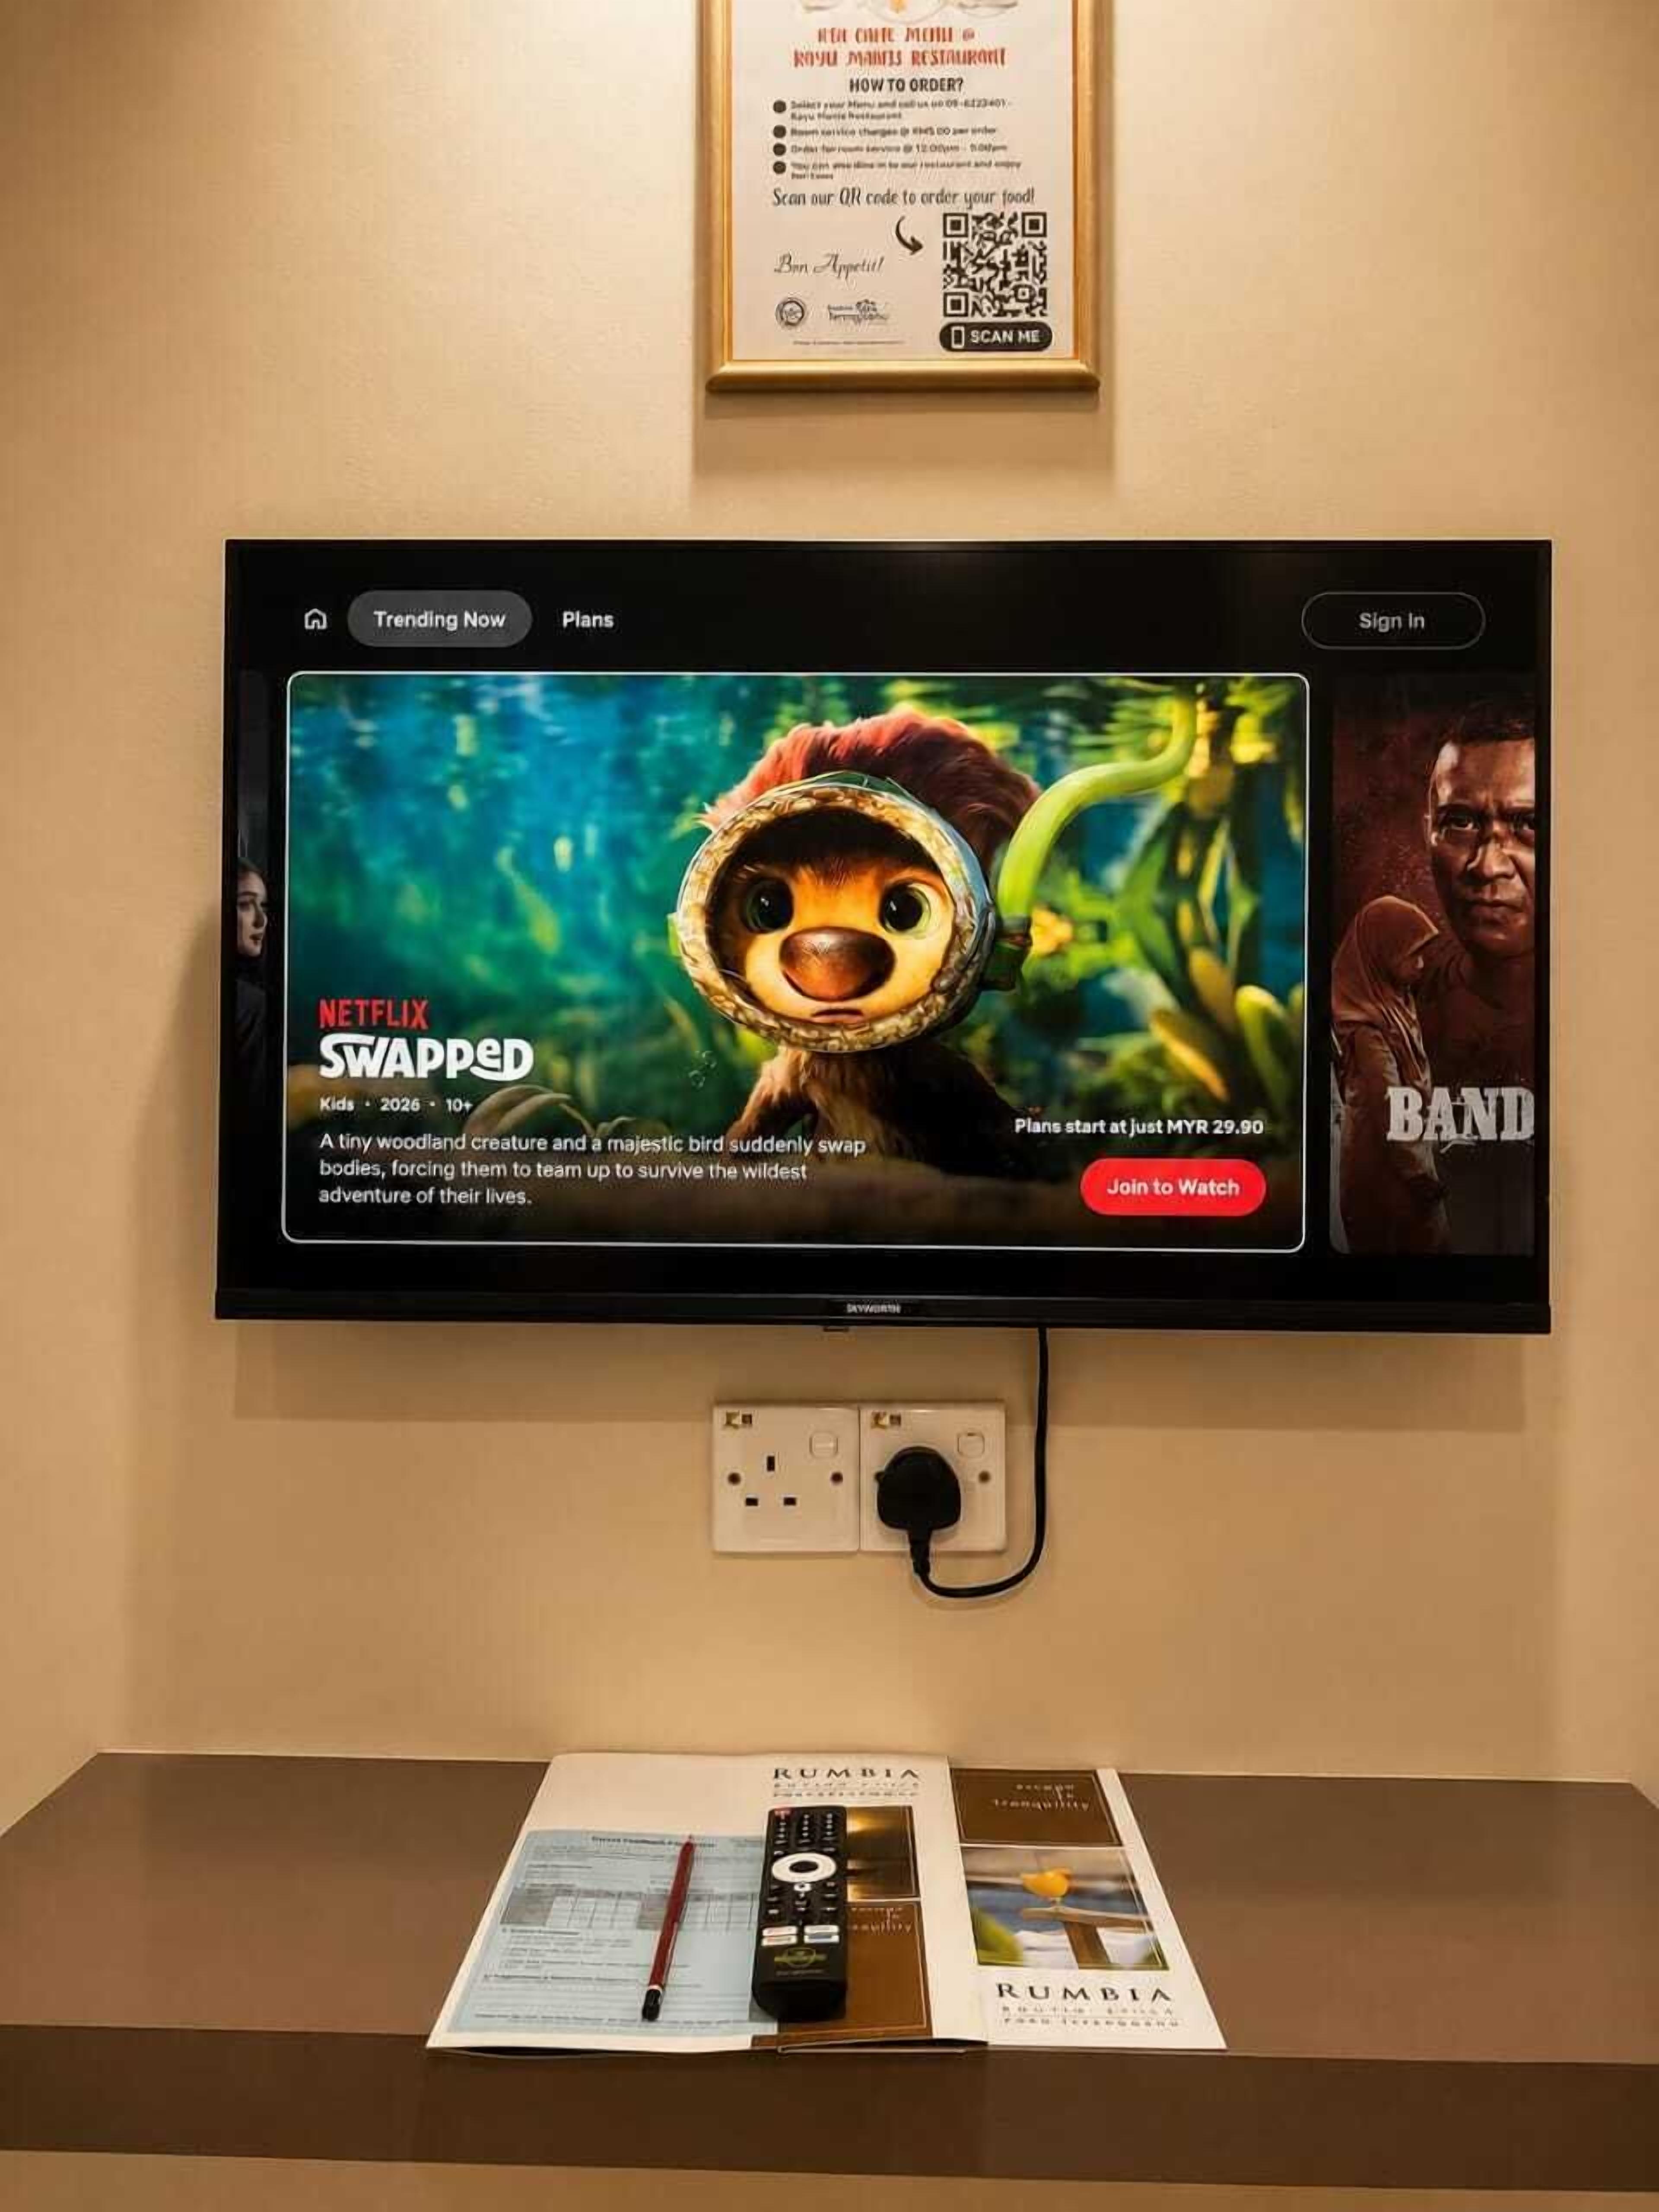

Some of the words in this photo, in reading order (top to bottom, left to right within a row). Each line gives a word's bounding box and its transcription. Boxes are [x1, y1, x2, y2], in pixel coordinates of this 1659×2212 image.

[912, 48, 1005, 67] RESTAURANT
[849, 78, 883, 92] HOW
[887, 78, 905, 92] TO
[909, 78, 963, 92] ORDER?
[773, 187, 806, 206] Scan
[811, 193, 834, 205] our
[840, 186, 861, 207] QR
[865, 187, 899, 205] code
[903, 188, 916, 205] to
[921, 188, 960, 205] order
[964, 192, 995, 209] your
[1002, 186, 1035, 207] food!
[970, 329, 1013, 343] SCAN
[1018, 330, 1040, 343] ME
[373, 610, 458, 631] Trending
[464, 610, 505, 628] Now
[563, 610, 614, 628] Plans
[1359, 613, 1402, 632] Sign
[1408, 613, 1424, 629] In
[319, 999, 429, 1030] NETFLIX
[320, 1098, 354, 1111] Kids
[380, 1098, 420, 1112] 2026
[446, 1098, 474, 1112] 10+
[1386, 1086, 1535, 1141] BAND
[1015, 1118, 1061, 1134] Plans
[1065, 1119, 1106, 1134] start
[1109, 1119, 1126, 1134] at
[1128, 1118, 1163, 1138] just
[1167, 1119, 1209, 1135] MYR
[1212, 1119, 1265, 1135] 29.90
[320, 1134, 334, 1149] A
[340, 1133, 373, 1154] tiny
[376, 1133, 466, 1150] woodland
[471, 1135, 547, 1151] creature
[553, 1135, 586, 1151] and
[591, 1138, 602, 1152] a
[608, 1135, 683, 1155] majestic
[689, 1135, 723, 1153] bird
[729, 1135, 812, 1156] suddenly
[817, 1140, 867, 1157] swap
[320, 1159, 386, 1180] bodies,
[391, 1159, 455, 1181] forcing
[461, 1160, 507, 1177] them
[512, 1161, 531, 1177] to
[537, 1161, 581, 1178] team
[587, 1165, 610, 1183] up
[615, 1163, 633, 1179] to
[638, 1162, 703, 1180] survive
[709, 1163, 737, 1179] the
[742, 1163, 807, 1180] wildest
[318, 1188, 411, 1204] adventure
[416, 1186, 433, 1203] of
[439, 1187, 479, 1204] their
[486, 1188, 532, 1205] lives.
[1107, 1178, 1149, 1196] Join
[1154, 1179, 1173, 1196] to
[1179, 1178, 1240, 1196] Watch
[996, 1983, 1172, 2003] RUMBIA
